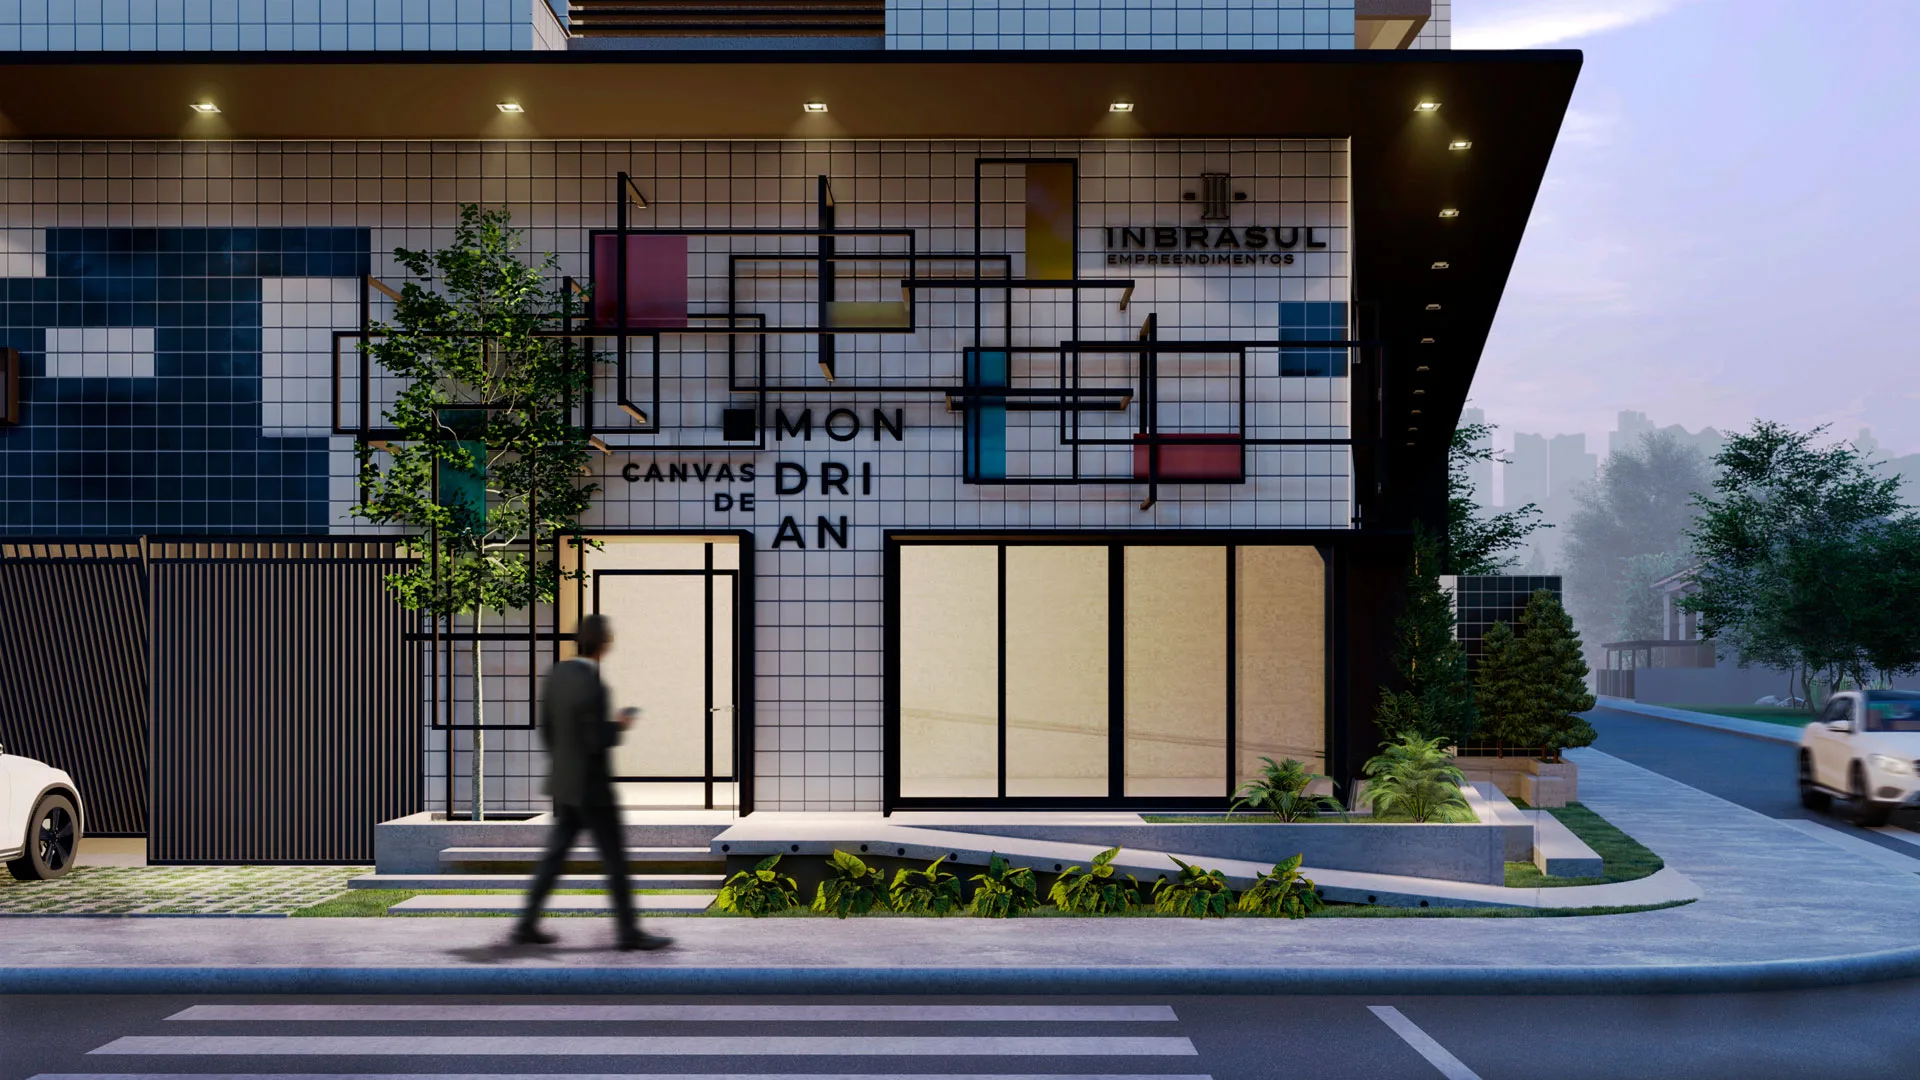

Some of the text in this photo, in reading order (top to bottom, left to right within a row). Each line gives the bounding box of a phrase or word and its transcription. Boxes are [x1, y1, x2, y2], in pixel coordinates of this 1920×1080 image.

[1105, 226, 1327, 249] INBRASUL
[1107, 254, 1295, 265] EMPREENDIMENTOS
[775, 408, 903, 442] MON
[622, 463, 756, 483] CANVAS
[775, 462, 871, 495] DRI
[714, 493, 756, 512] DE
[771, 516, 848, 549] AN
